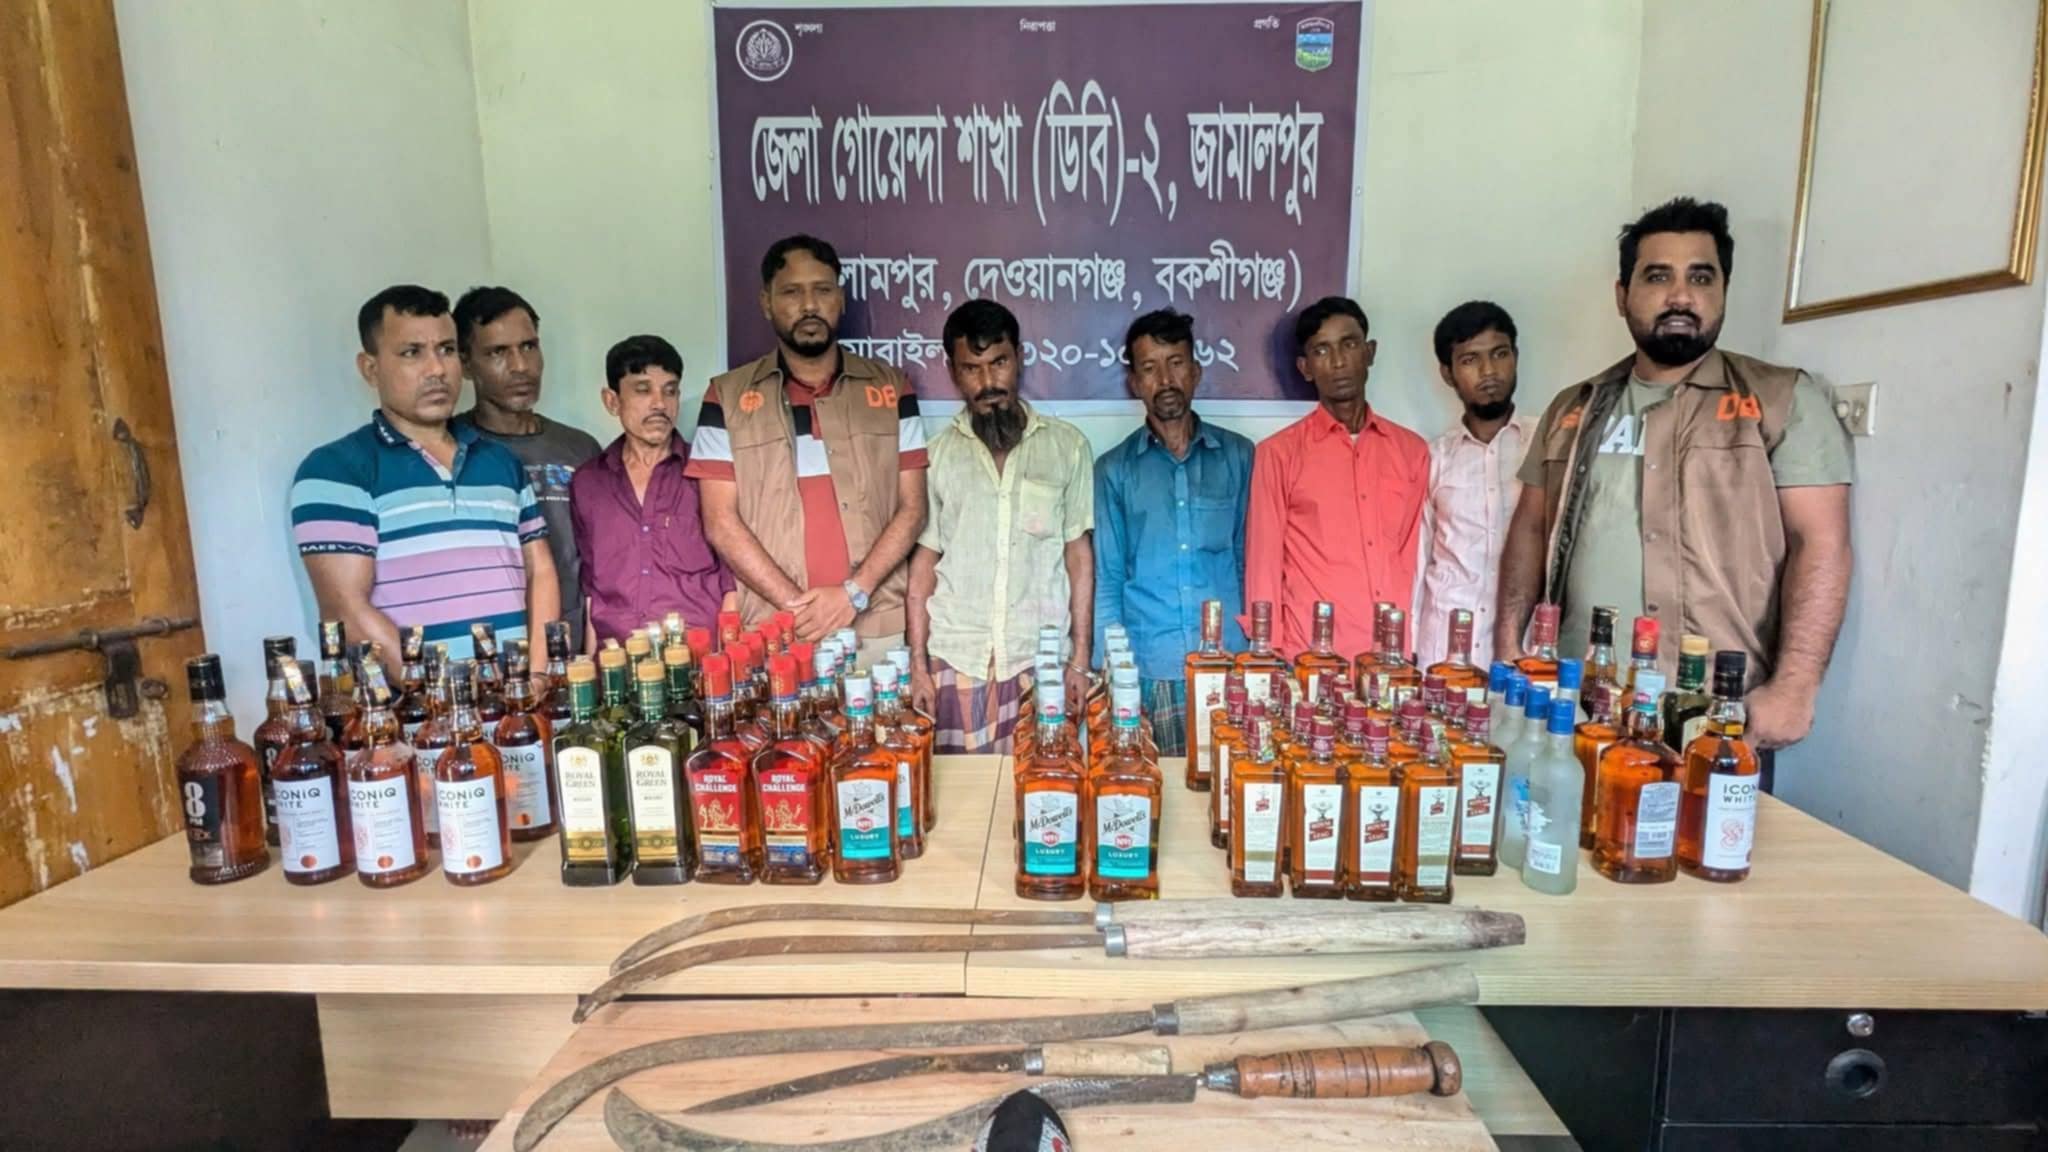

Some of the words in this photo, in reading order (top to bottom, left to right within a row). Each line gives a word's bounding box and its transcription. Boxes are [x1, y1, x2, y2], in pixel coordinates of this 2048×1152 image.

[751, 104, 823, 204] জেলা
[831, 102, 948, 204] গোয়েন্দা
[953, 101, 1024, 204] শাখা
[1033, 79, 1177, 226] (ডিবি)-২,
[1187, 100, 1324, 226] জামালপুর
[185, 782, 206, 818] 8
